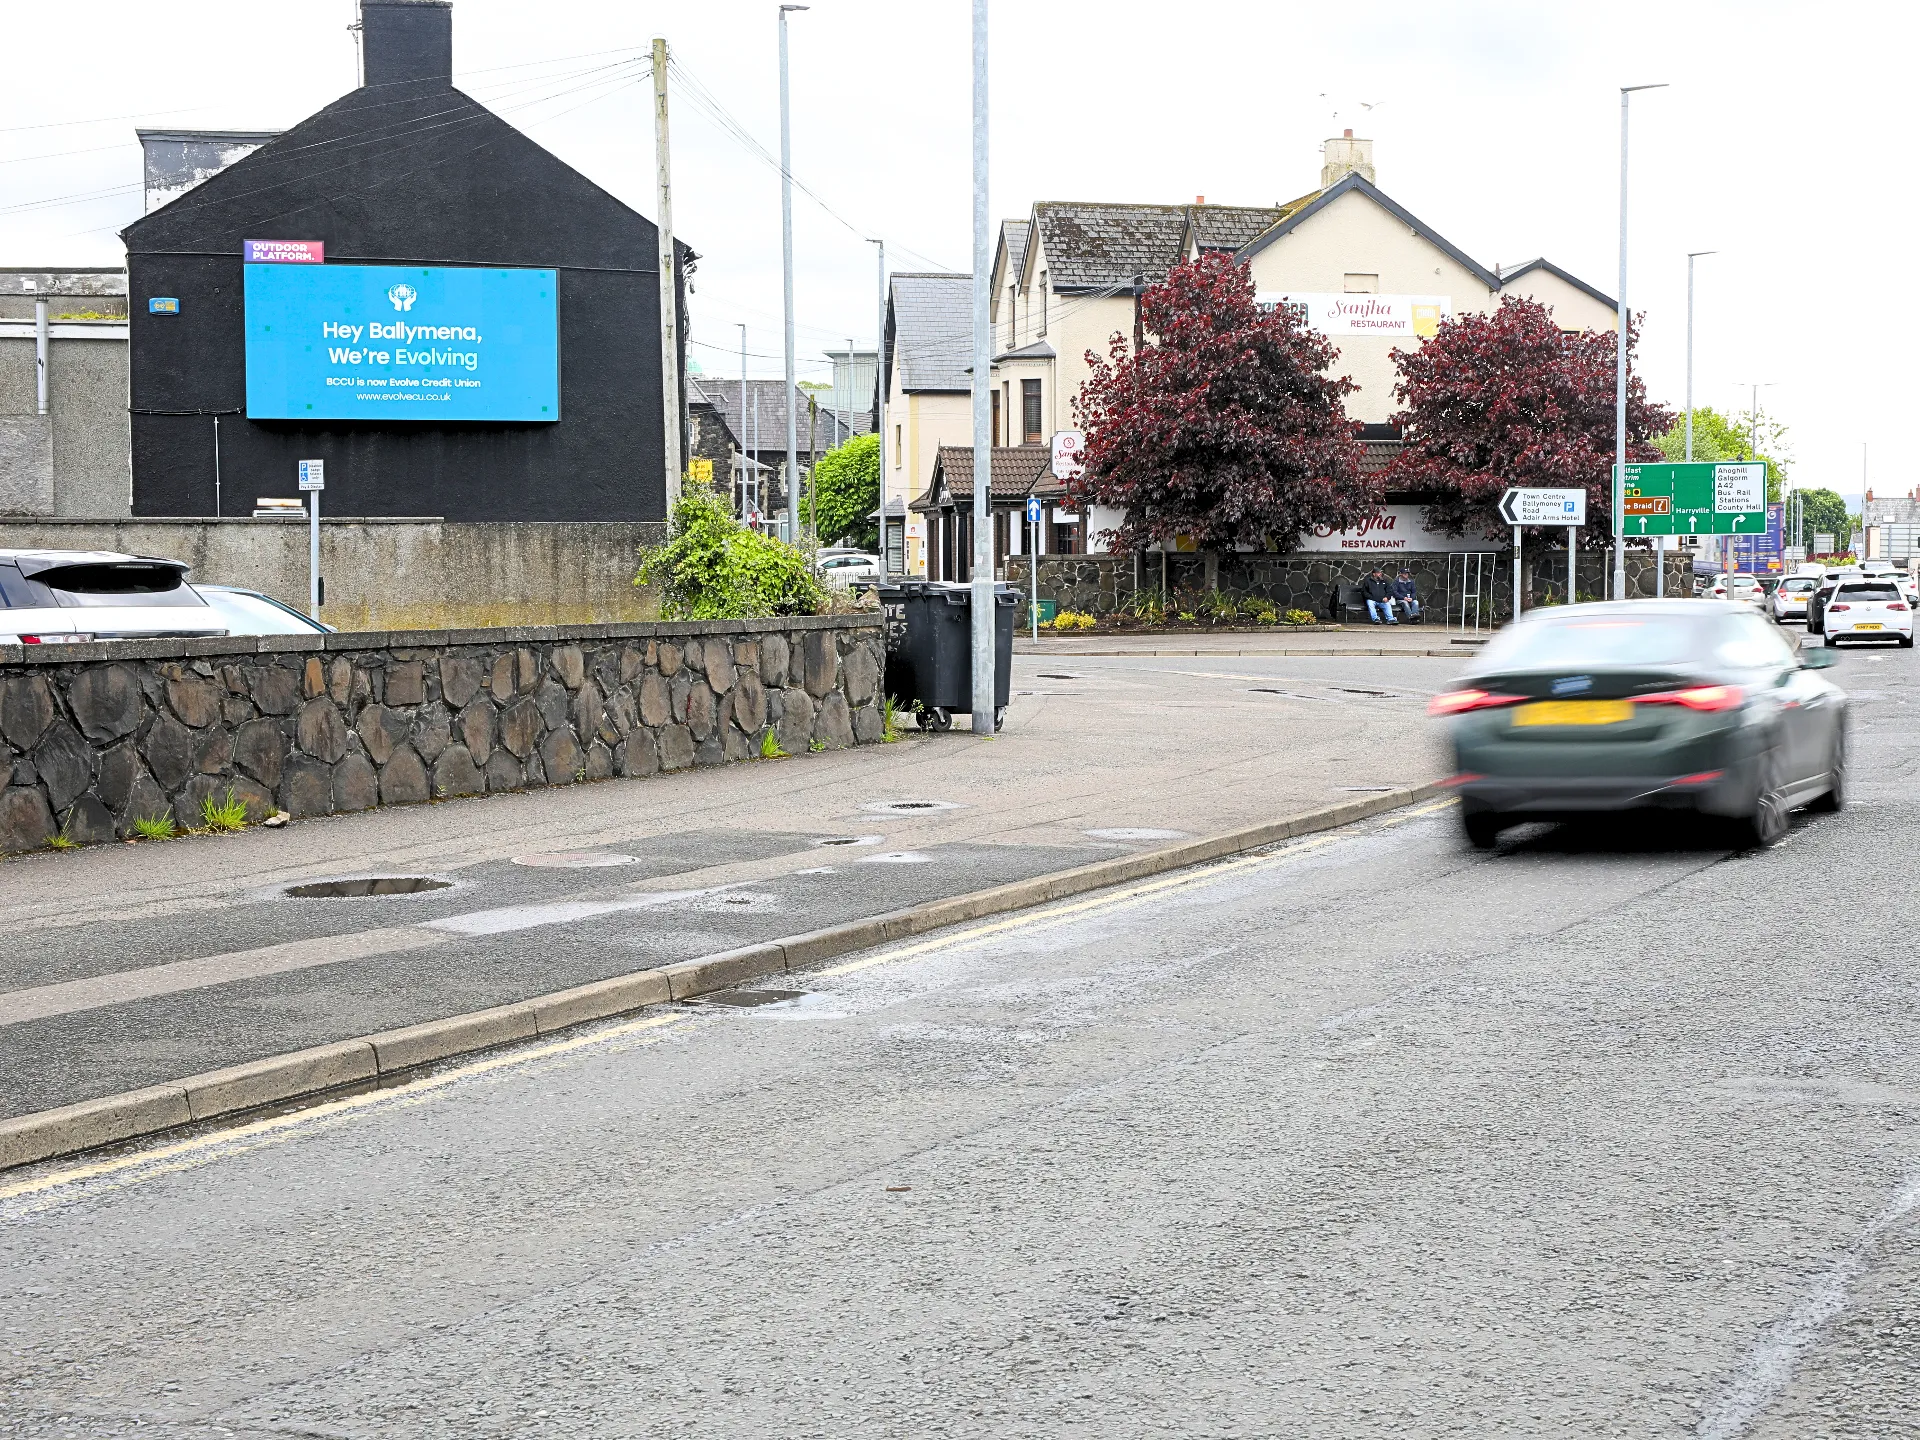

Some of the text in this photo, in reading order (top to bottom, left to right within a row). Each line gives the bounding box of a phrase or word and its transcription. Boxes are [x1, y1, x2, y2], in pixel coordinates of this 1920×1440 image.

[252, 242, 308, 252] OUTDOOR
[252, 251, 315, 261] PLATFORM.
[1327, 299, 1392, 319] Sanjha
[1350, 319, 1407, 329] RESTAURANT
[323, 321, 483, 345] Hey Ballymena,
[328, 347, 478, 371] We're Evolving
[326, 376, 481, 388] BCCU is now Evolve Credit Union
[356, 391, 452, 401] www.evolvecu.co.uk
[1717, 467, 1748, 475] Ahoghill
[1522, 500, 1561, 508] Ballymoney
[1675, 507, 1710, 515] Harryville
[1341, 539, 1406, 549] RESTAURANT
